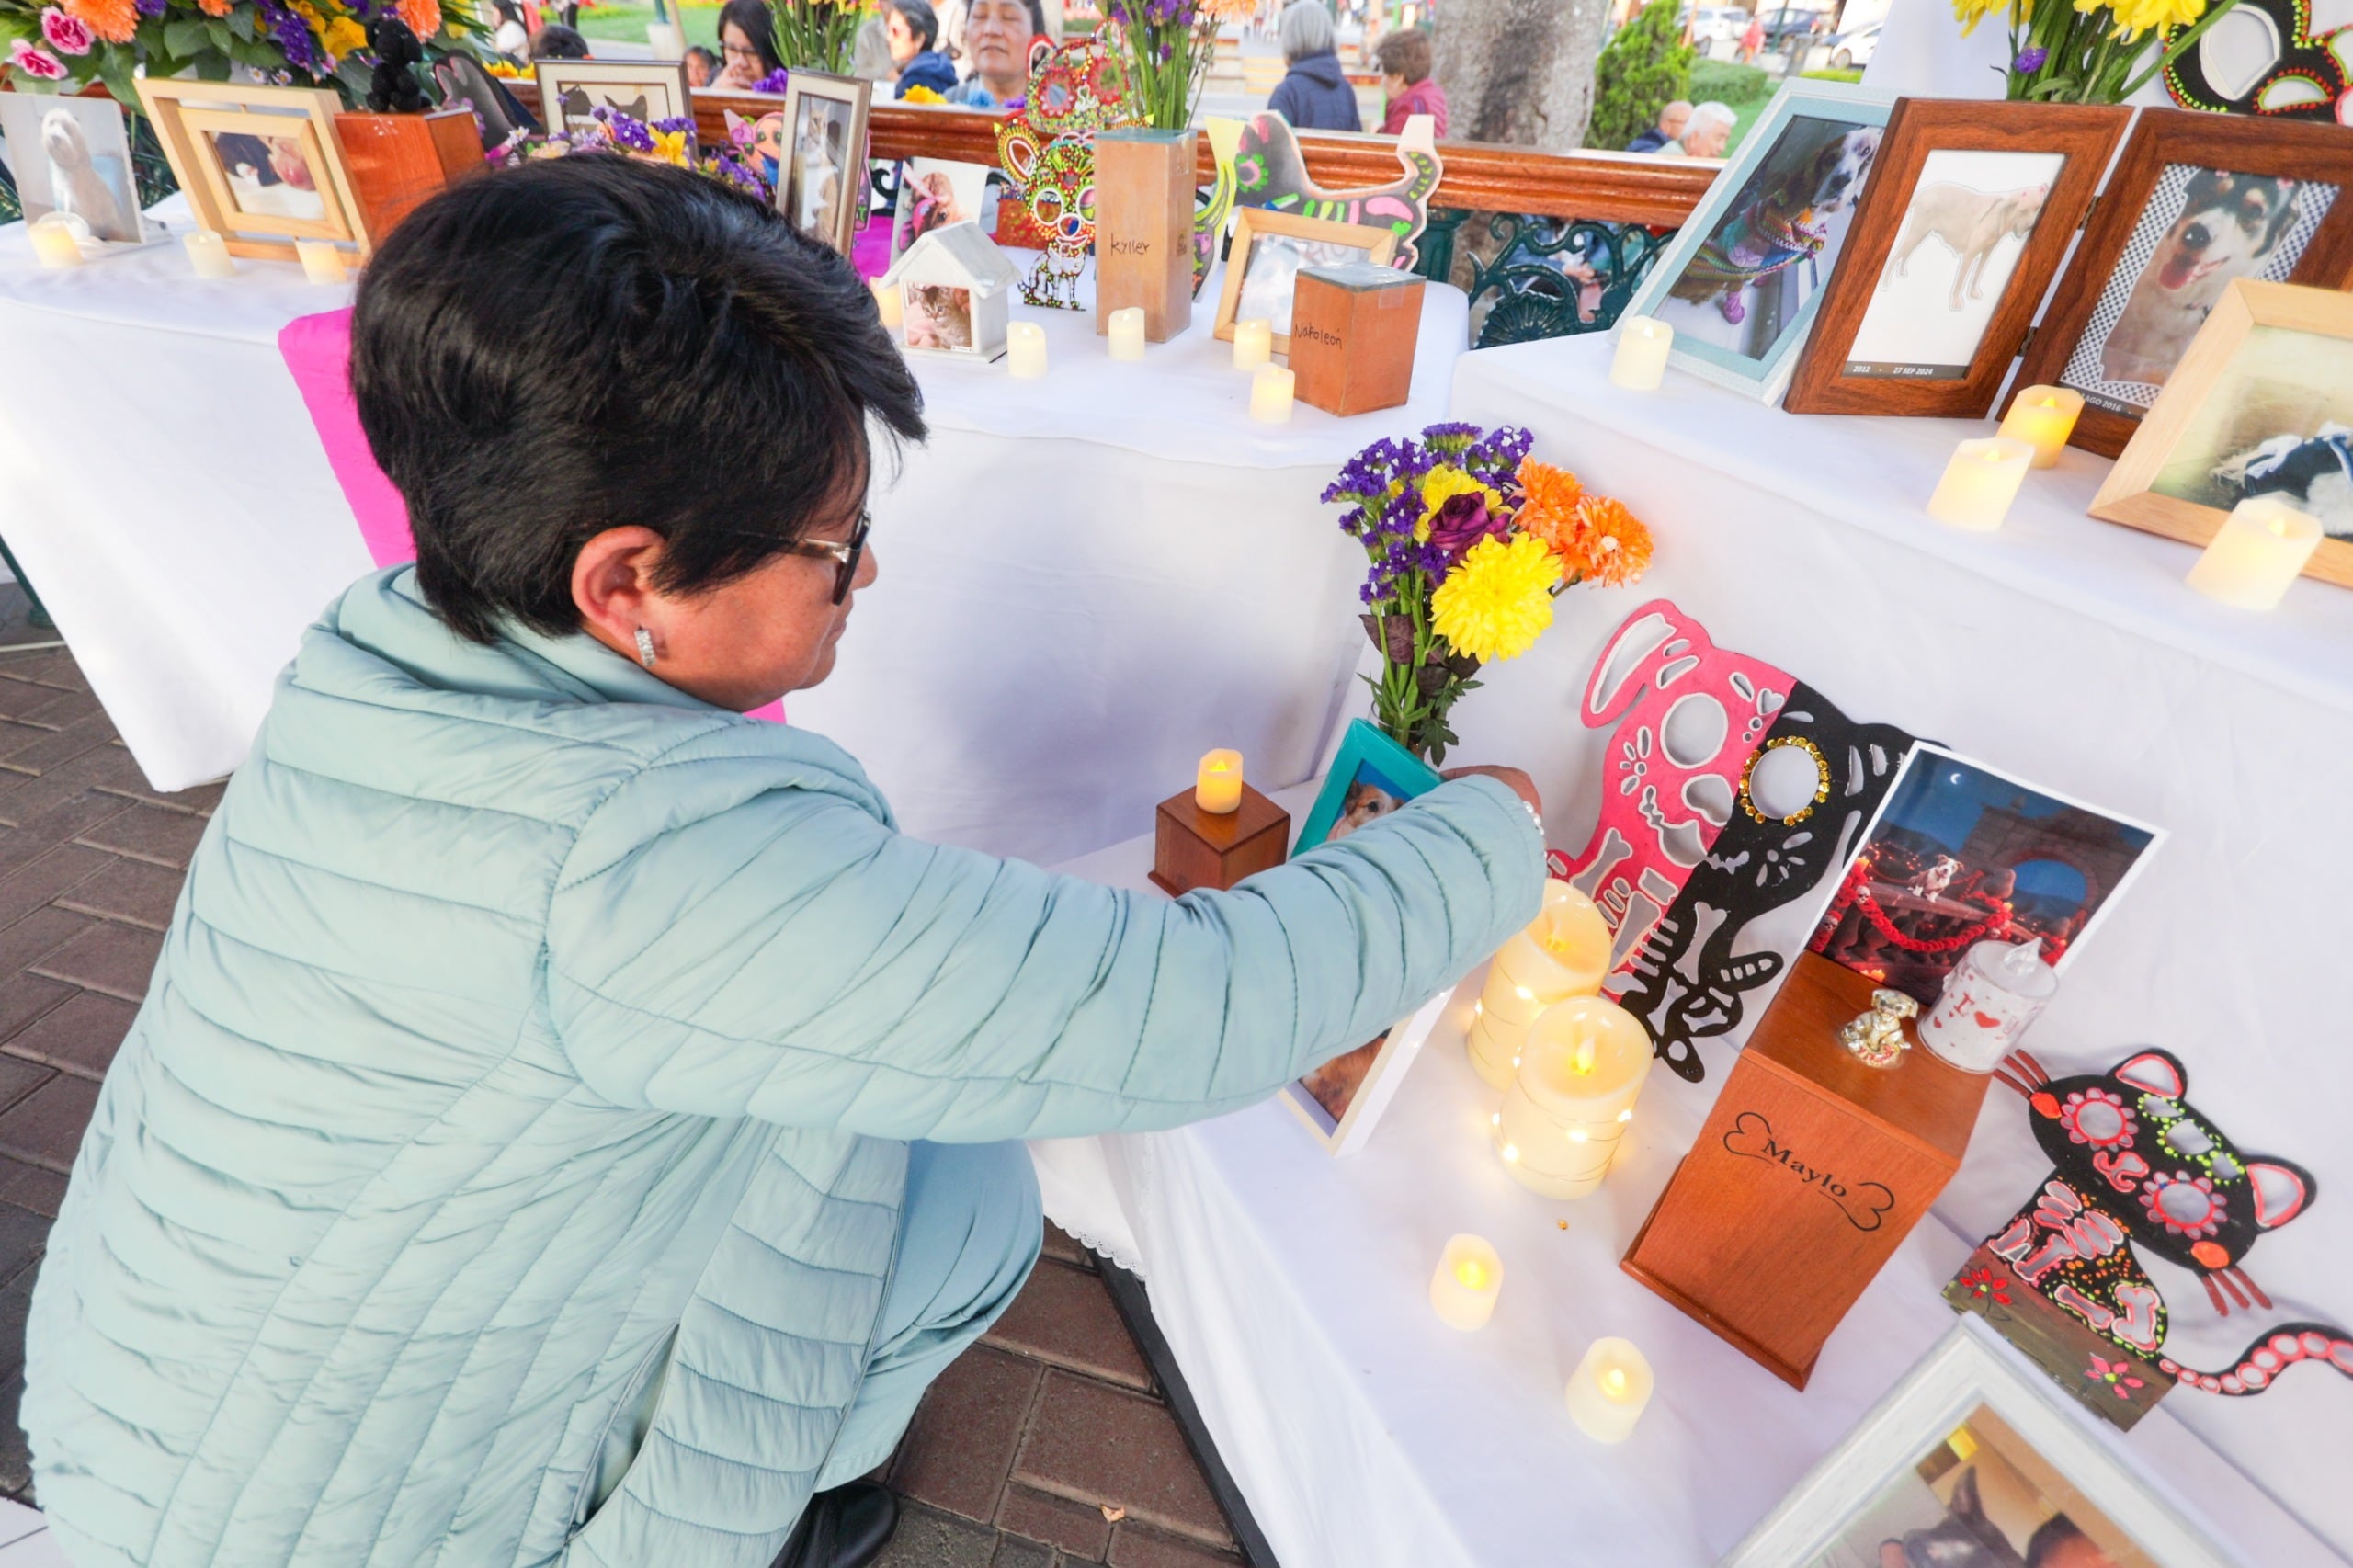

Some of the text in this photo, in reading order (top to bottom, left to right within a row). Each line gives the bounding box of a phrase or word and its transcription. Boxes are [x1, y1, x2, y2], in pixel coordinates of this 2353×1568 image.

[1853, 365, 1870, 373] 2012
[1893, 367, 1902, 375] 27
[1915, 368, 1934, 376] 2024
[2101, 400, 2122, 412] 2016
[1761, 1139, 1847, 1198] Maylo
